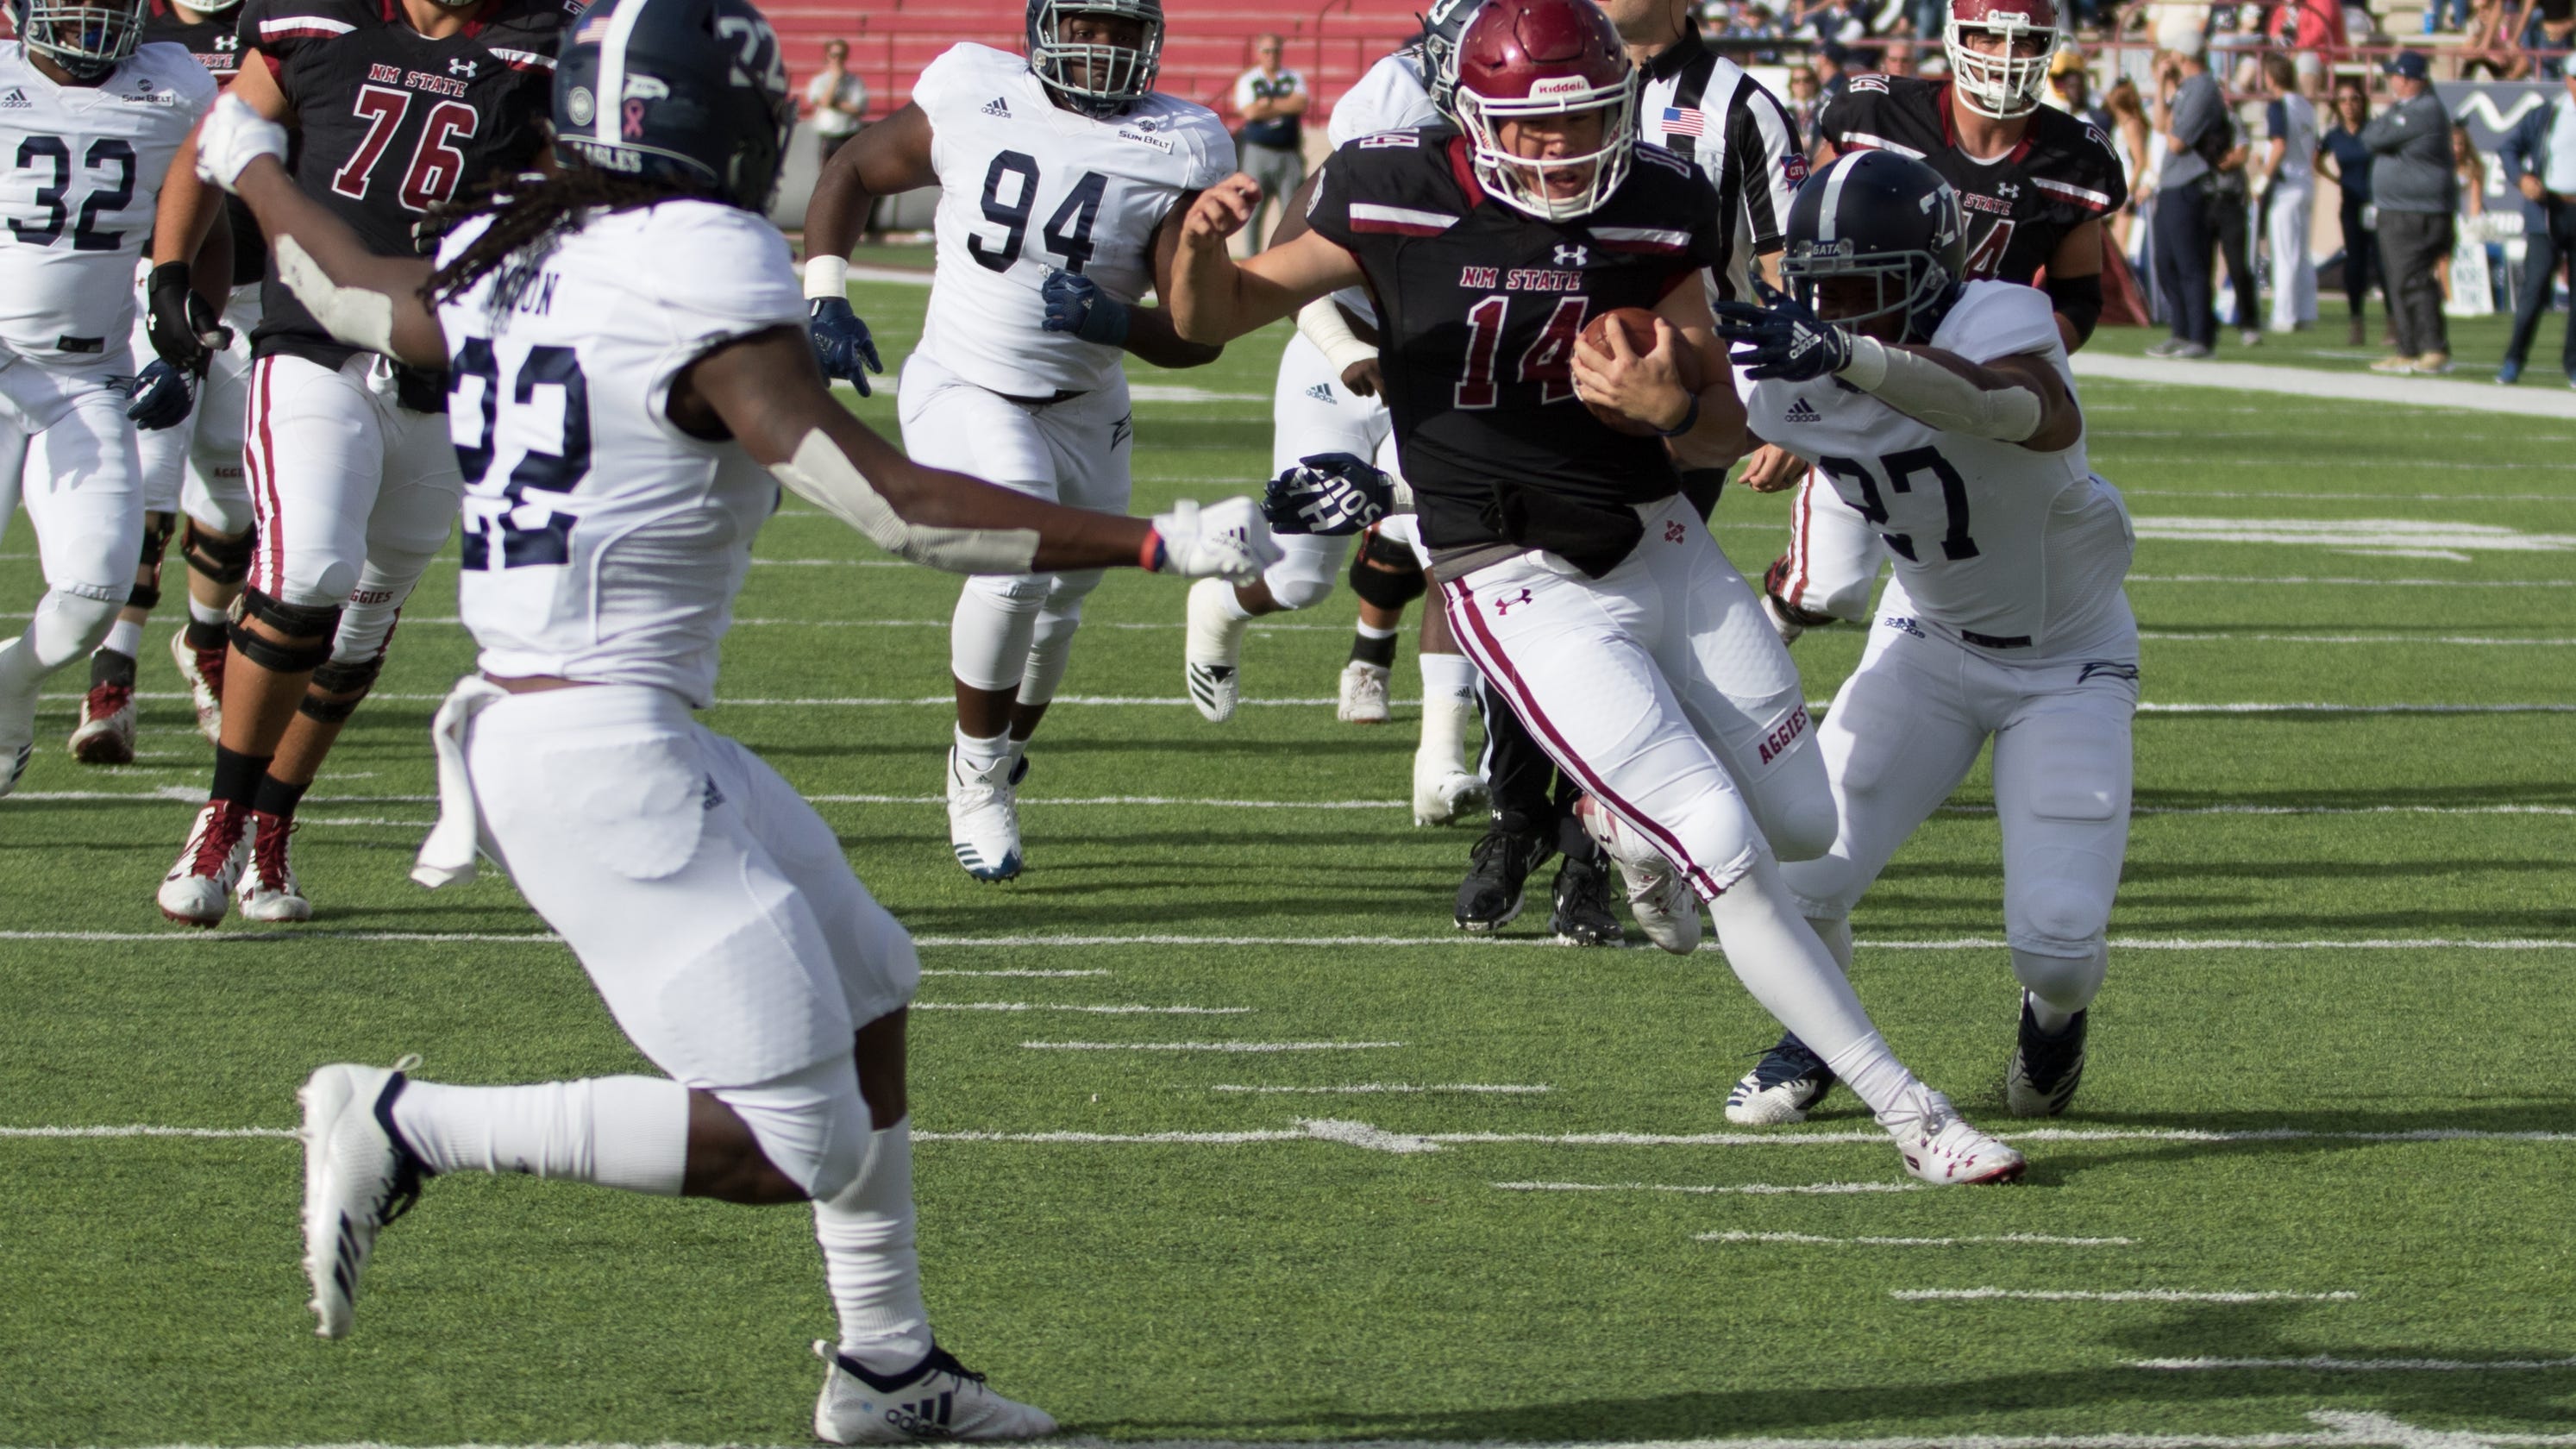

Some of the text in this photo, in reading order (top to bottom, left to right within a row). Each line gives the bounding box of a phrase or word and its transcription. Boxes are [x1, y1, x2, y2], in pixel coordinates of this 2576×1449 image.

[191, 53, 235, 68] TATE
[717, 16, 787, 92] 22
[368, 63, 468, 97] NM STATE
[2, 99, 32, 108] adidas
[146, 94, 172, 103] BELT
[981, 106, 1012, 119] adidas
[331, 84, 479, 213] 76
[1119, 130, 1170, 150] SUN BELT
[7, 136, 136, 250] 32
[1964, 192, 2013, 216] STATE
[967, 148, 1111, 274] 94
[1960, 210, 2016, 282] 4
[1459, 266, 1583, 292] NM STATE
[1454, 295, 1589, 410] 14
[1784, 413, 1821, 423] adidas
[1819, 444, 1981, 562] 27
[350, 588, 393, 604] GGIES
[1758, 704, 1807, 765] AGGIES
